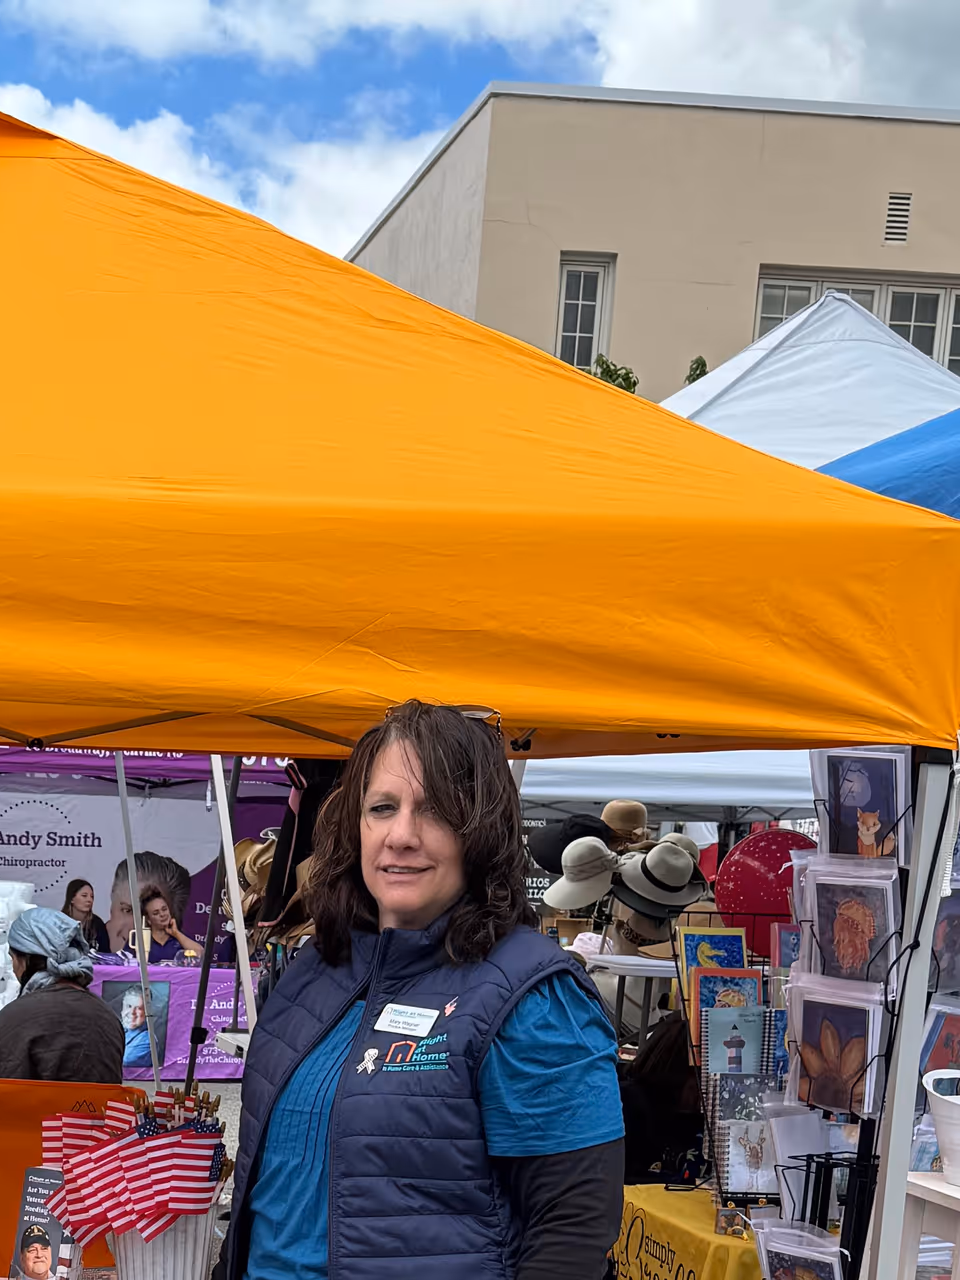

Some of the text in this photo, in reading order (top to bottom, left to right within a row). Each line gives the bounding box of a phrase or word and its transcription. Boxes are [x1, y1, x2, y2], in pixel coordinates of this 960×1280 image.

[46, 831, 102, 848] Smith
[419, 1033, 447, 1047] Right
[414, 1045, 426, 1054] at
[644, 1233, 677, 1274] simply
